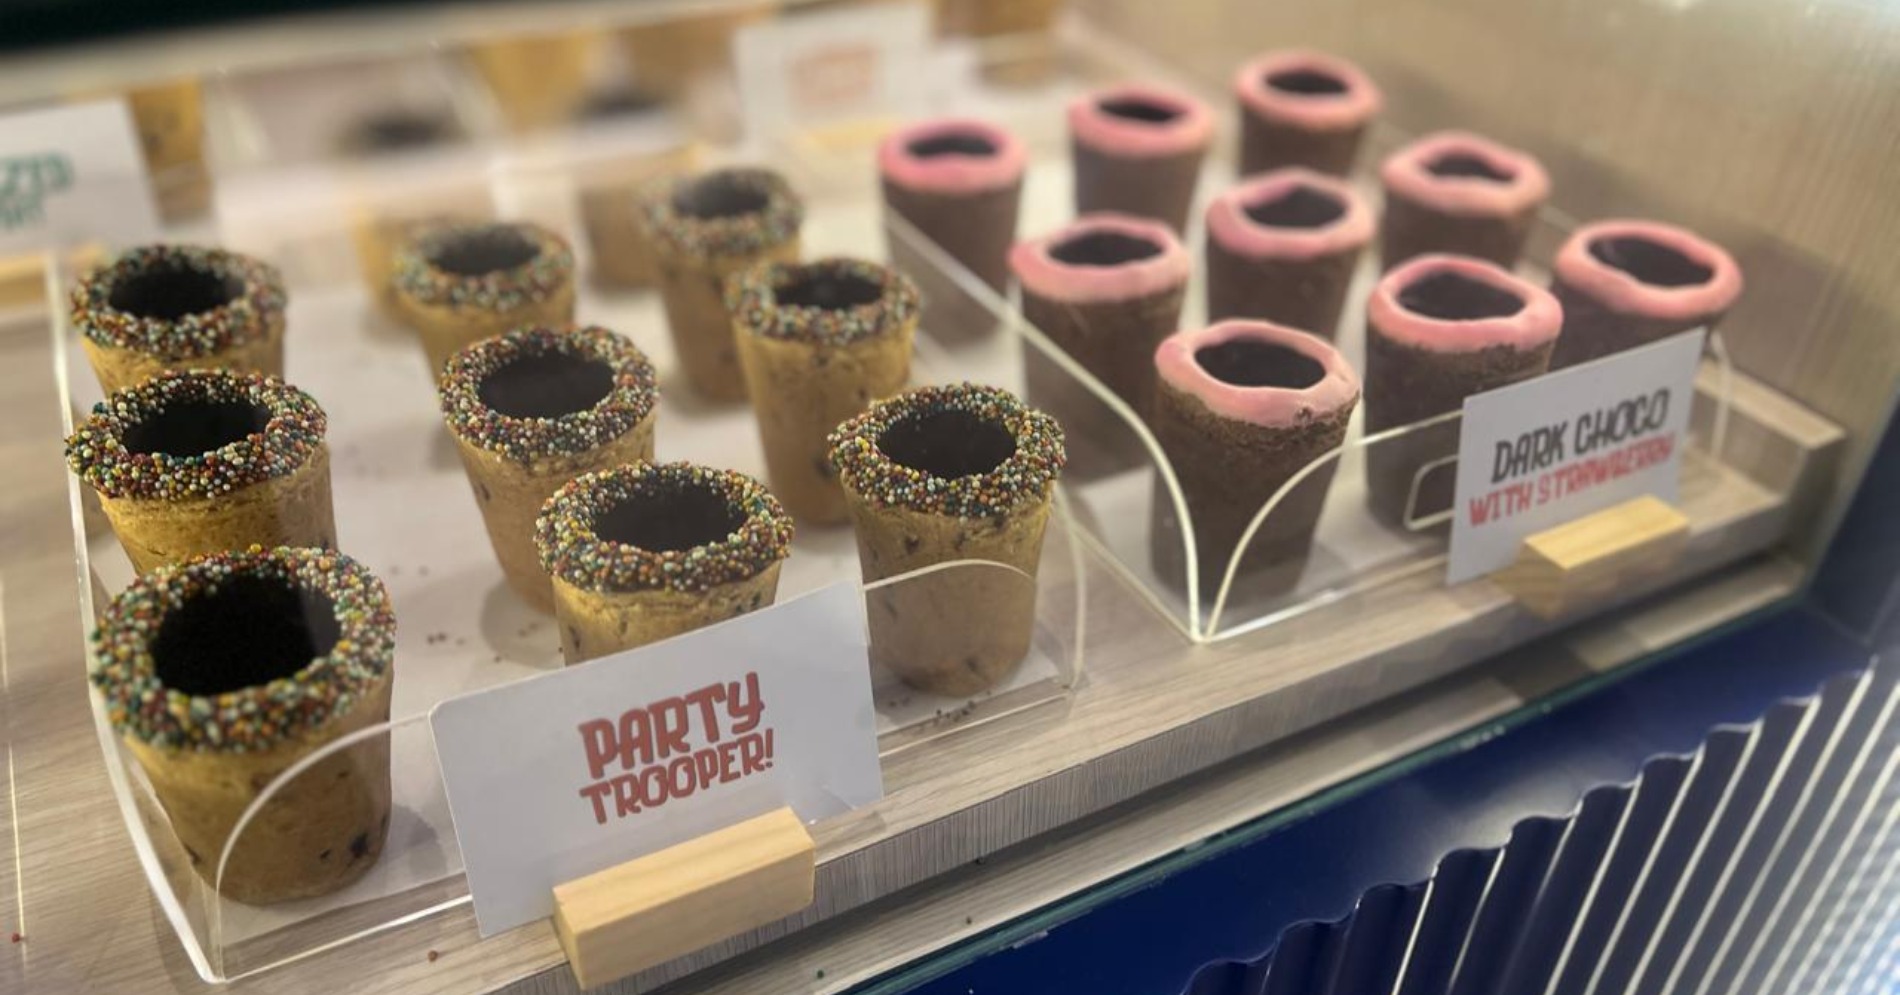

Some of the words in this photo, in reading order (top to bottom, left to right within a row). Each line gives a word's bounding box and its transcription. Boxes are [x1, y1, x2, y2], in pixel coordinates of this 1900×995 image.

[1491, 422, 1567, 483] DARK
[1574, 388, 1671, 454] CHOCO
[1469, 483, 1534, 528] WITH
[578, 672, 765, 779] PARTY
[579, 728, 773, 824] TROOPER!
